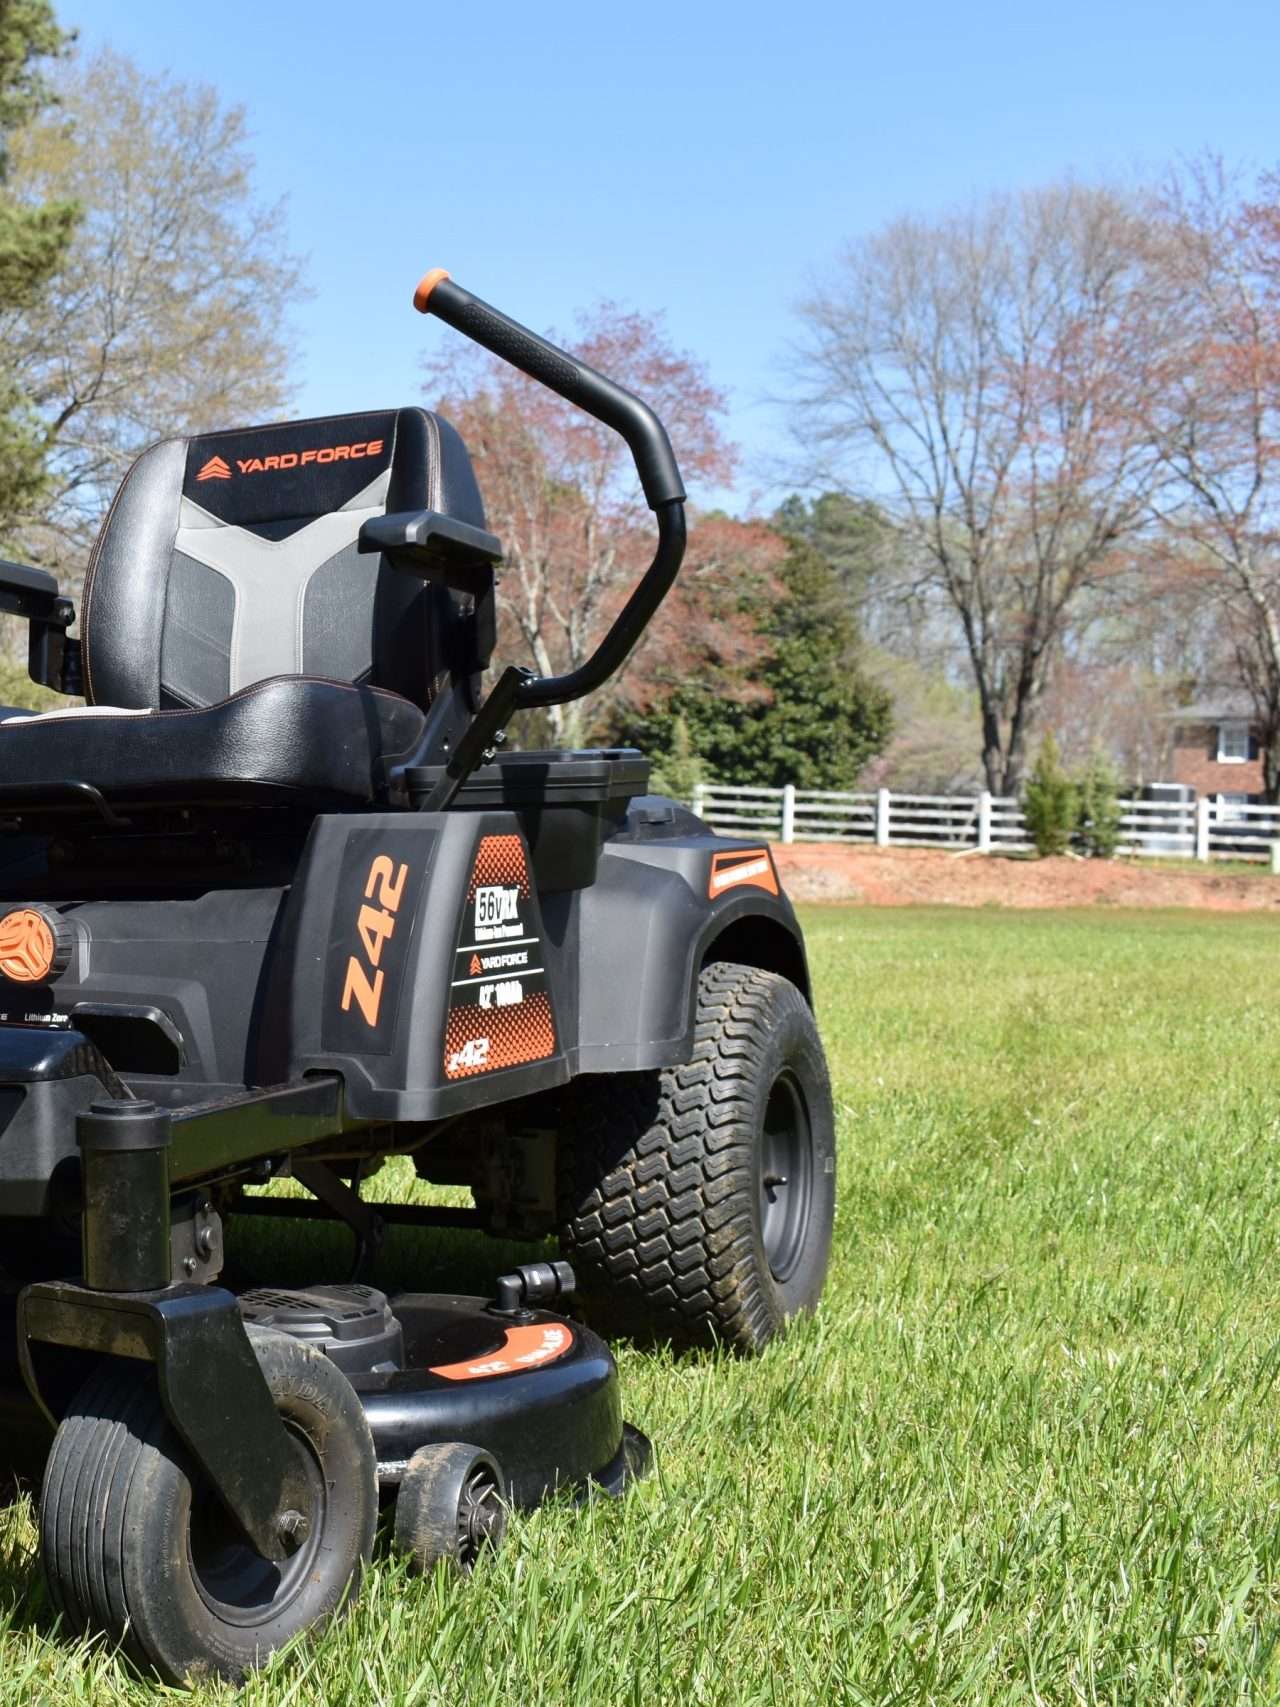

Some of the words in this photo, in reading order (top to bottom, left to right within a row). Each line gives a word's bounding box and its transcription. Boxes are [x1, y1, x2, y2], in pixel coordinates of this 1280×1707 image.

[236, 453, 298, 474] YARD
[300, 439, 385, 466] FORCE
[341, 855, 409, 1028] Z42
[480, 954, 501, 970] YARD
[501, 950, 529, 967] FORCE
